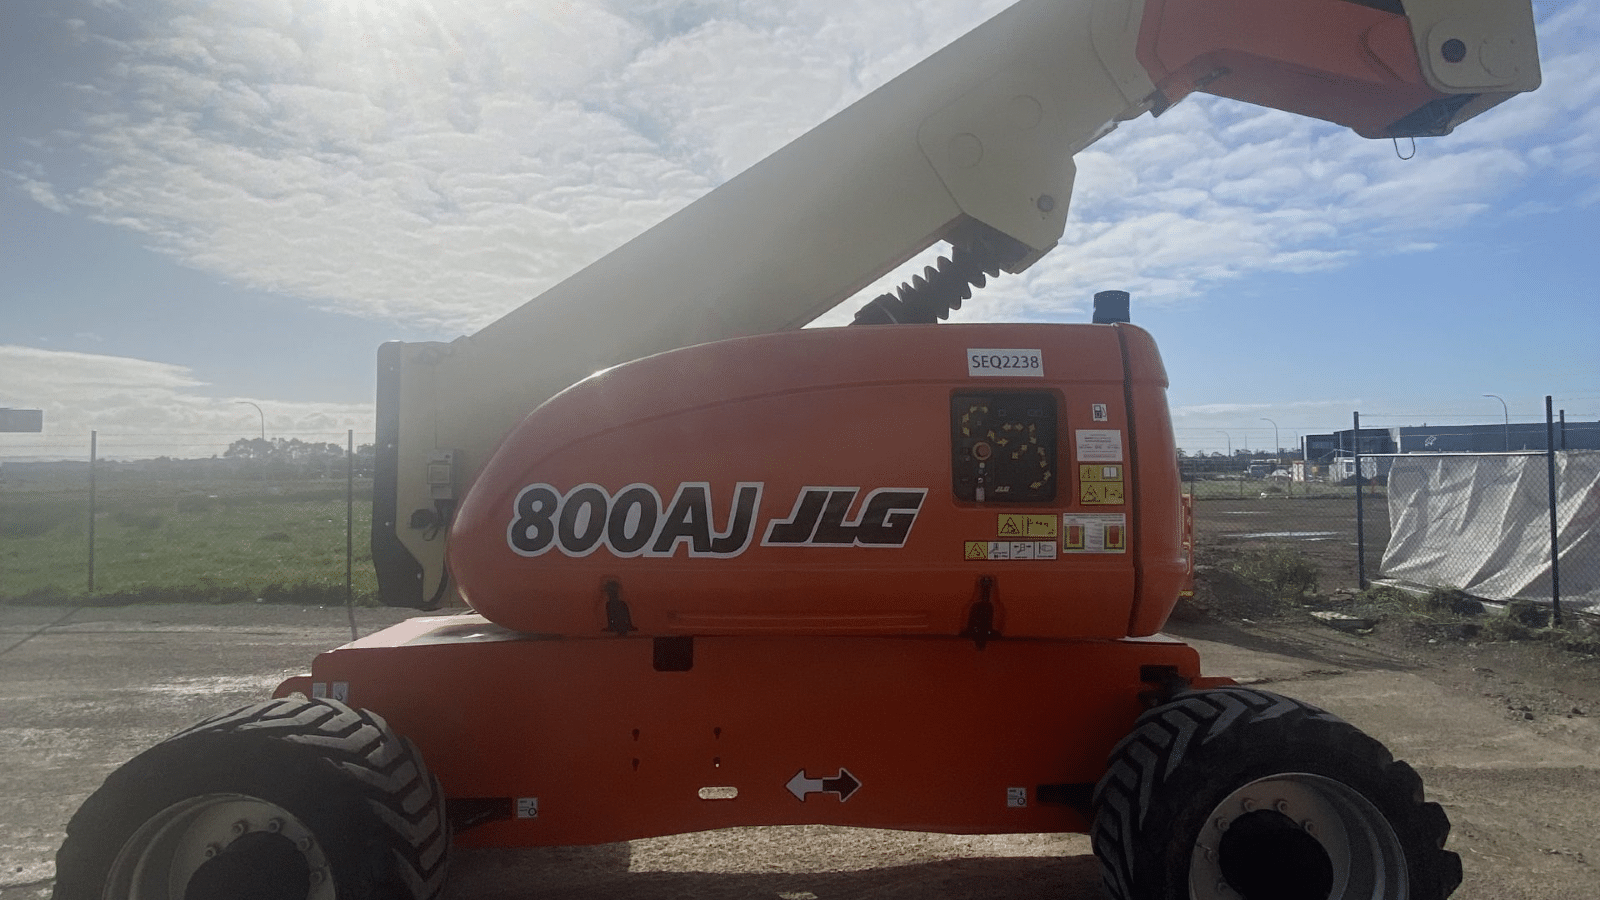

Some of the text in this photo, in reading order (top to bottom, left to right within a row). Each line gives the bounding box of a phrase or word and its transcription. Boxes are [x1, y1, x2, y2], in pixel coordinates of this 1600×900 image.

[972, 355, 1039, 369] SEQ2238
[507, 482, 928, 558] 800AJ JLG
